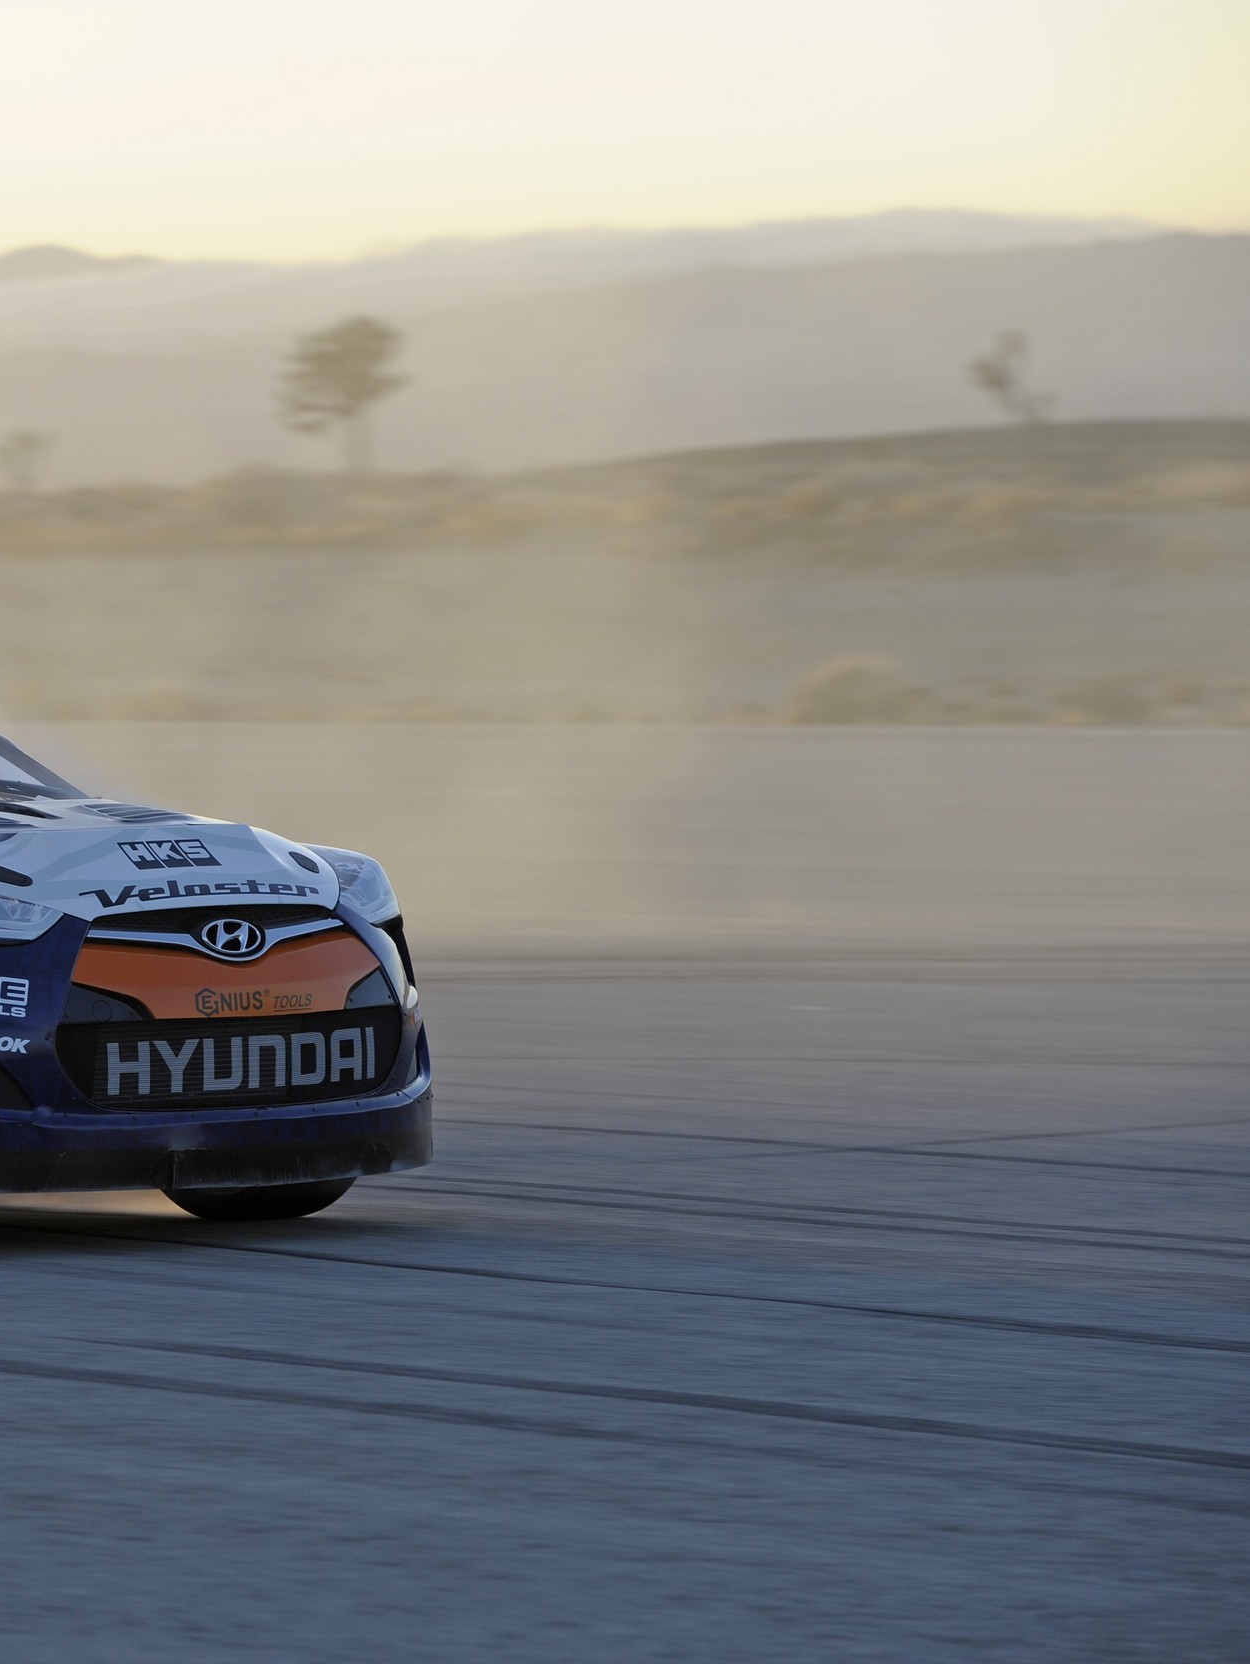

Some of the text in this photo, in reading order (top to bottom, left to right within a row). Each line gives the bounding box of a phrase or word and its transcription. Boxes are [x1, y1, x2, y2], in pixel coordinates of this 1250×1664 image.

[117, 839, 222, 870] HKS
[79, 880, 319, 908] Veloster
[273, 993, 312, 1009] TOOLS
[106, 1026, 376, 1096] HYUNDAI
